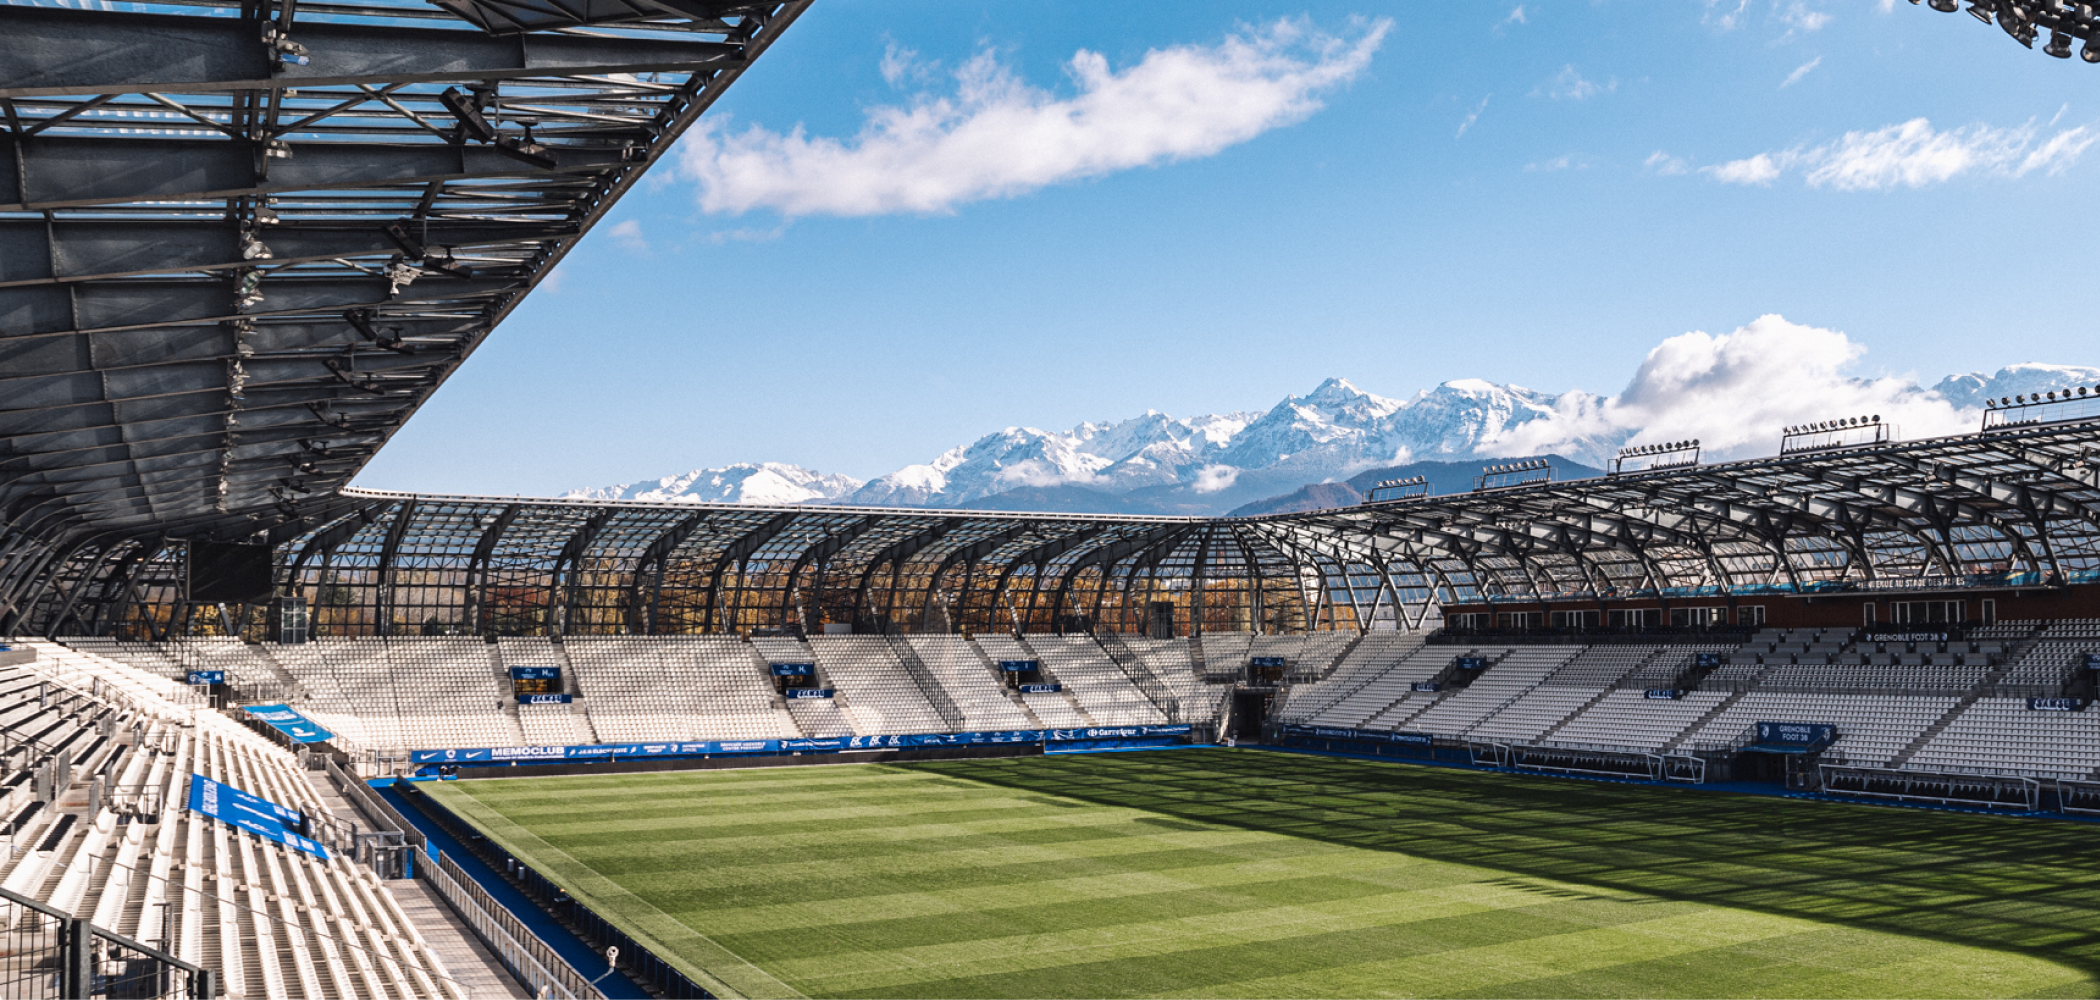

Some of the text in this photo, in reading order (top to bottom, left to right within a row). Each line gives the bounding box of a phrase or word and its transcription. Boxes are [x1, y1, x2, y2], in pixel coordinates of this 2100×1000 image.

[1874, 633, 1939, 641] GRENOBLE FOOT 38
[1780, 725, 1811, 733] GRENOBLE
[1782, 733, 1799, 741] FOOT
[492, 746, 565, 756] MEMOCLUB
